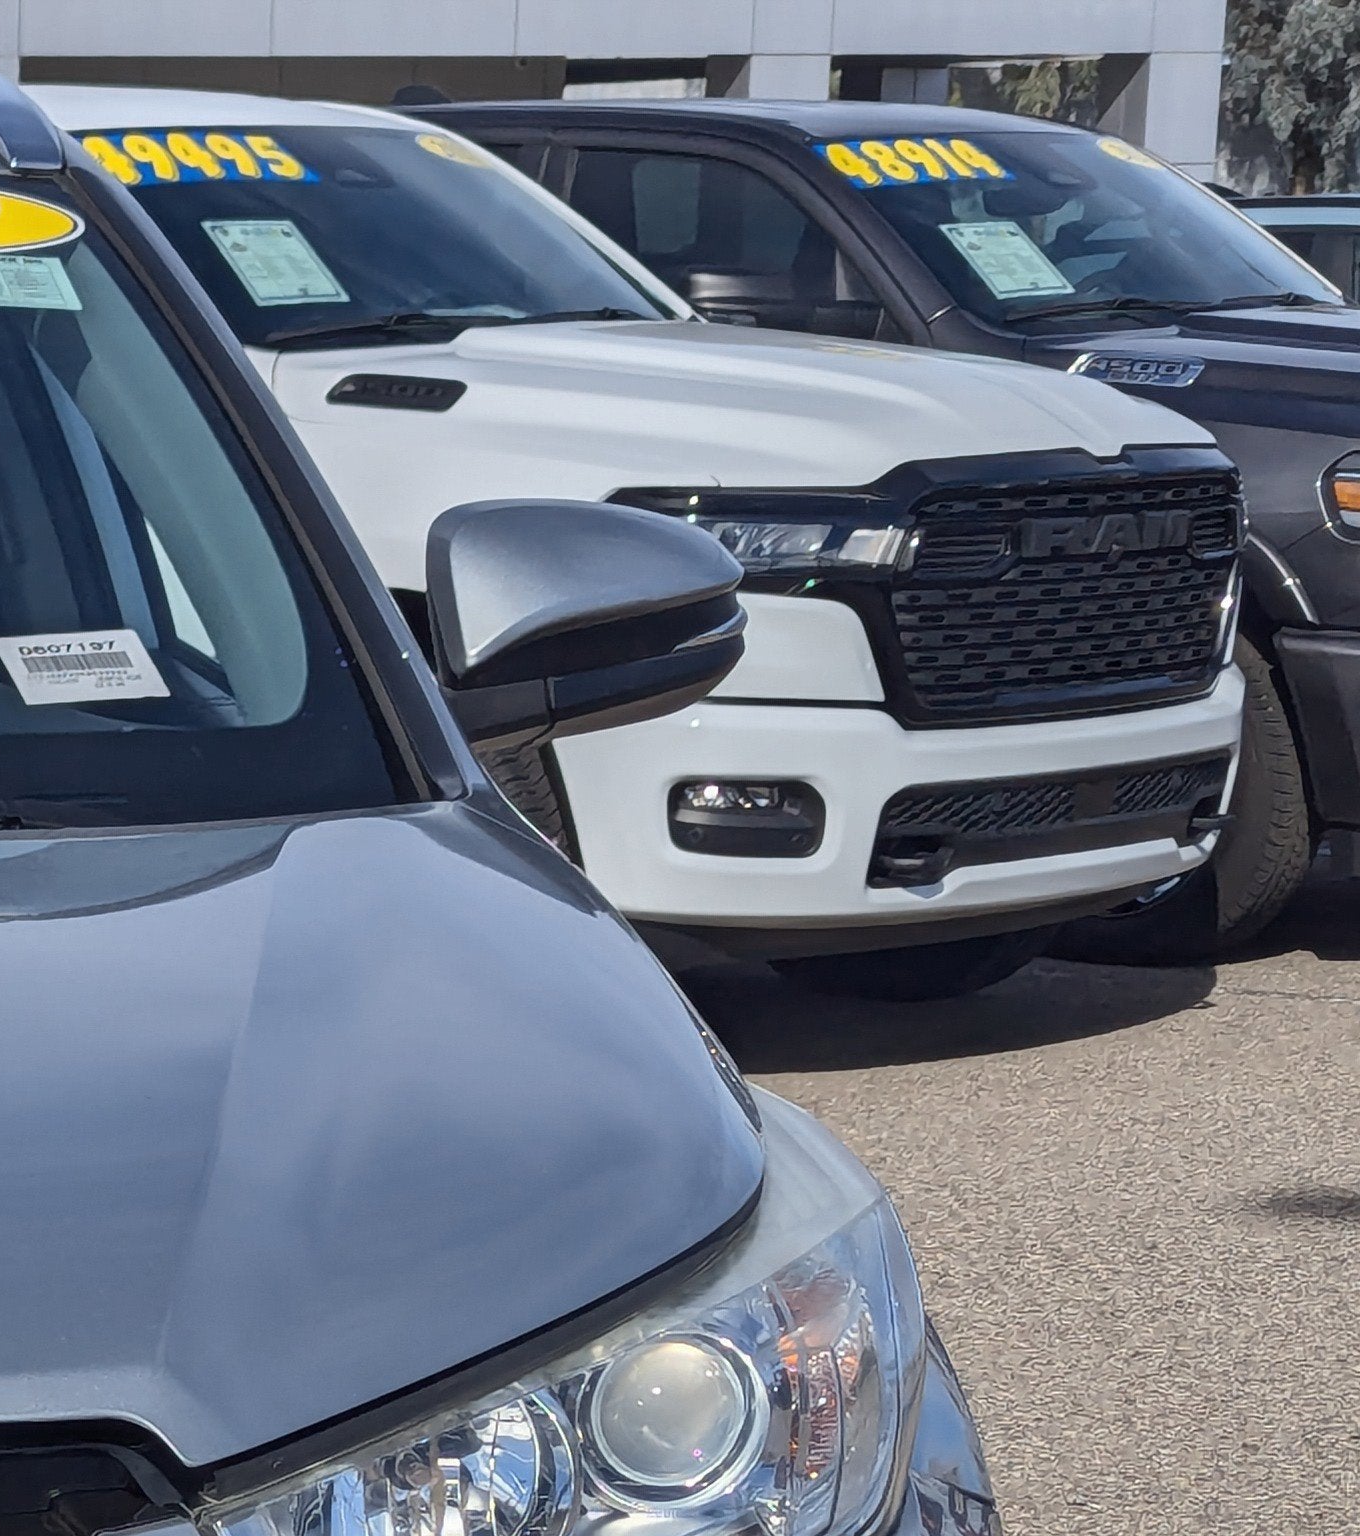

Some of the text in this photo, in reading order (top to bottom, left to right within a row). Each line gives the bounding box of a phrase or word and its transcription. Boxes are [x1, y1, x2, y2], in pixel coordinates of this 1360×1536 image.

[82, 132, 305, 185] 49495
[826, 139, 1007, 187] 48914
[1019, 509, 1192, 558] RAM
